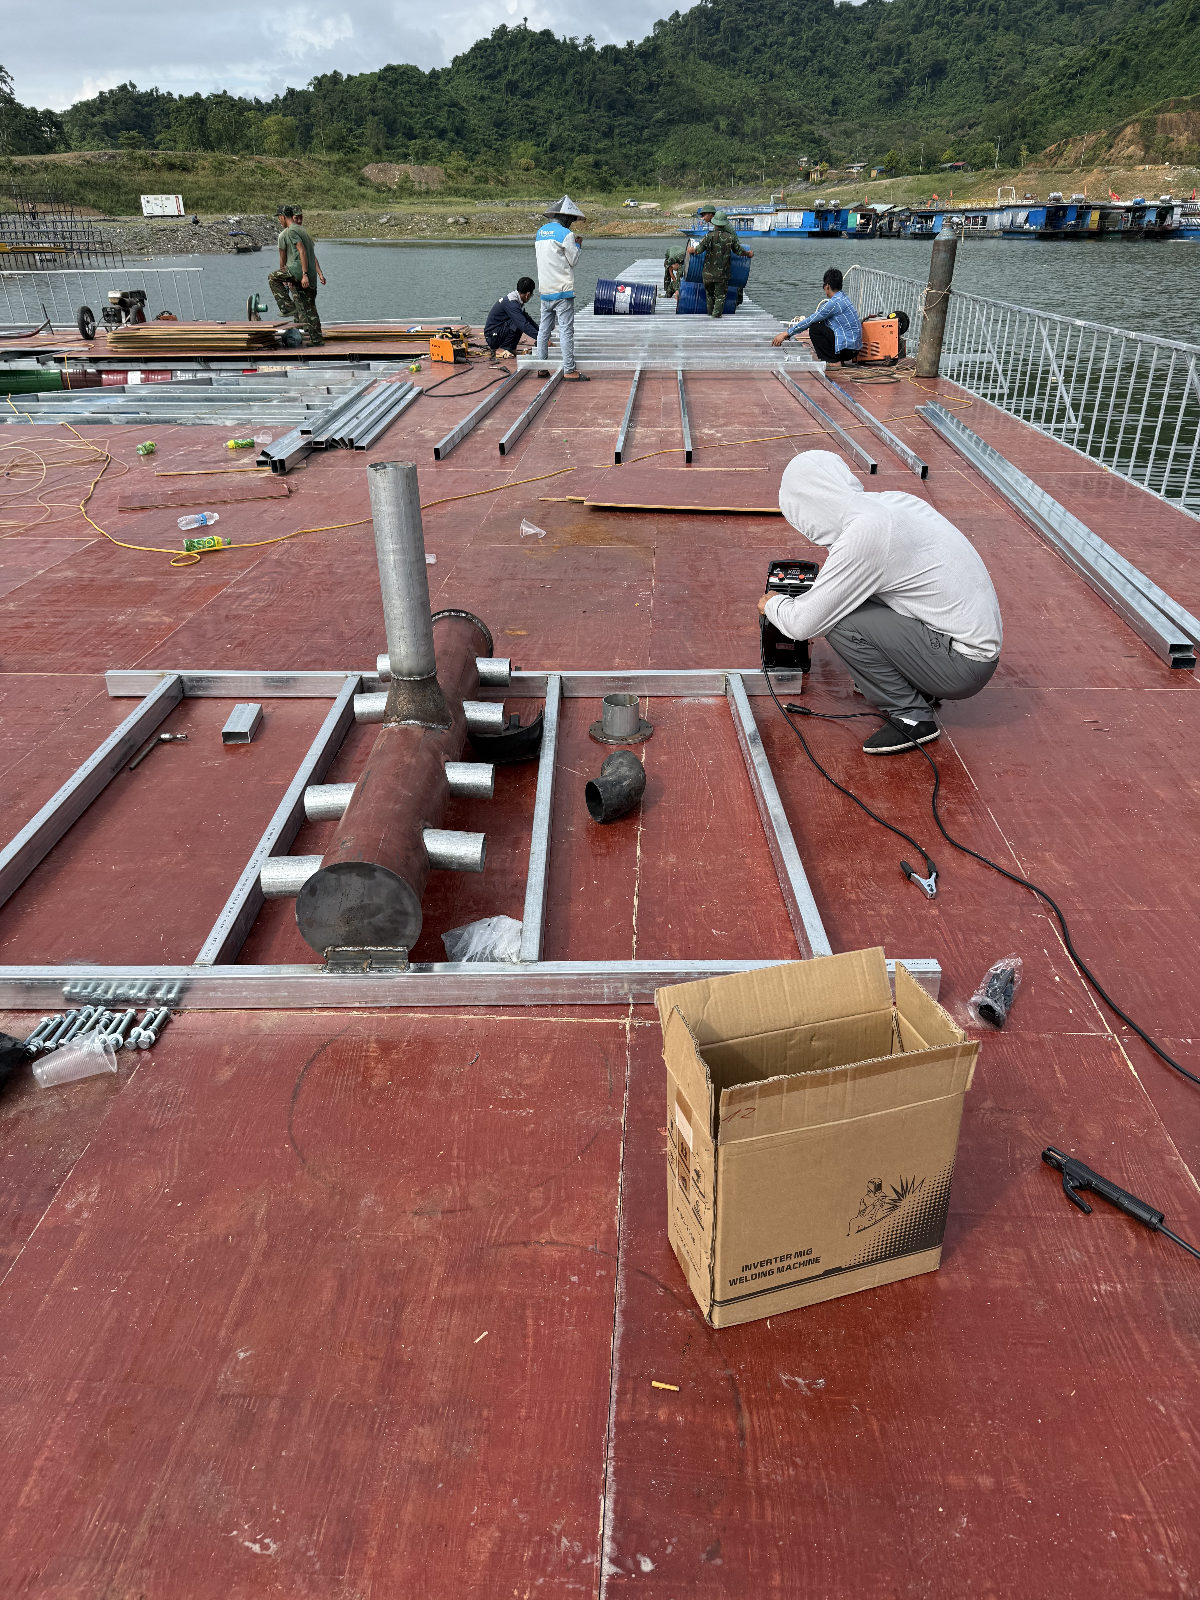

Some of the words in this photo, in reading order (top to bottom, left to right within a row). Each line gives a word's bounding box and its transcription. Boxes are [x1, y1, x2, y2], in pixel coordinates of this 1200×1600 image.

[729, 1269, 775, 1287] WELDING
[777, 1256, 822, 1274] MACHINE
[742, 1253, 792, 1272] INVERTER
[794, 1248, 813, 1260] MIG
